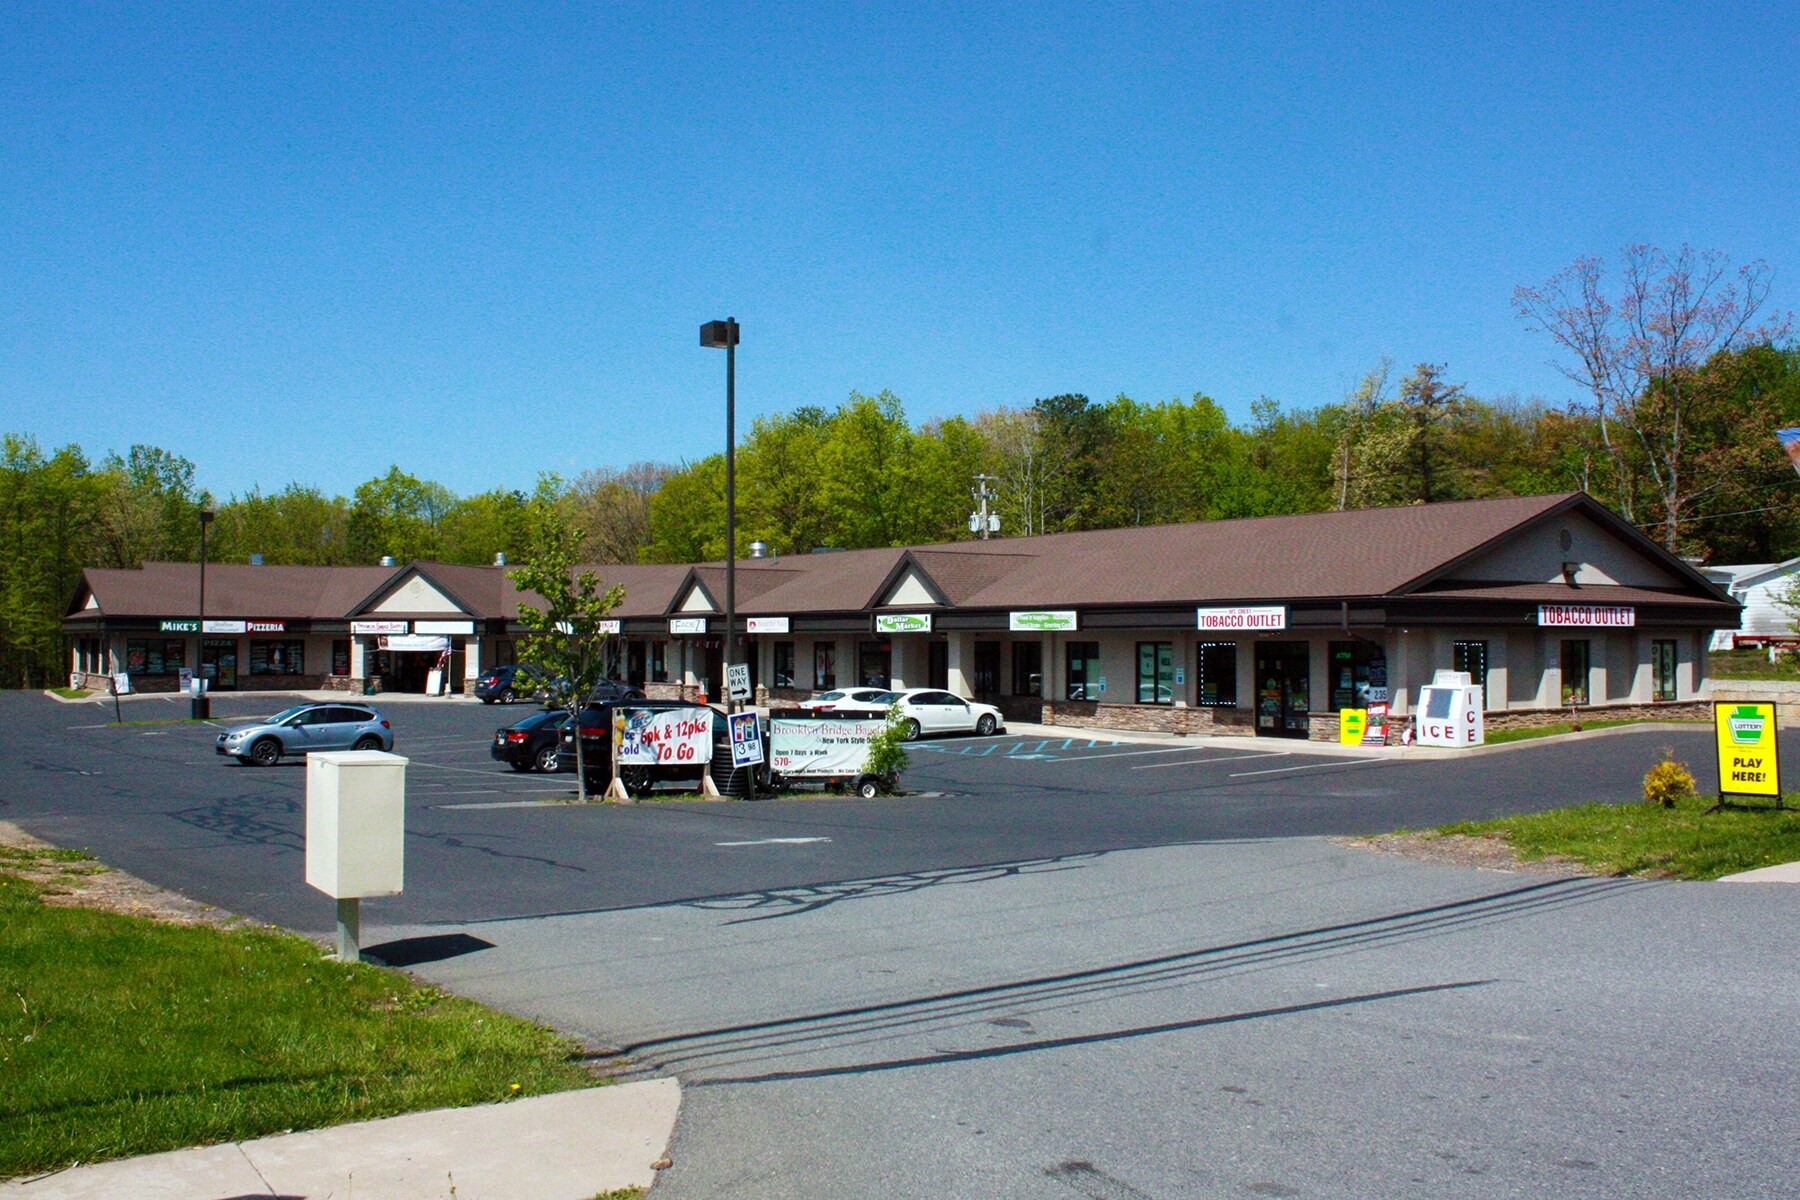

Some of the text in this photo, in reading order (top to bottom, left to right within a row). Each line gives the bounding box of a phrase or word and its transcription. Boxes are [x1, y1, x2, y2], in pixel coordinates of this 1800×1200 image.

[887, 616, 909, 624] Dollar
[1201, 614, 1282, 627] TOBACCO OUTLET
[1542, 606, 1632, 624] TOBACCO OUTLET
[162, 622, 197, 631] MIKE'S
[247, 623, 285, 631] PIZZERIA
[896, 622, 921, 631] Market
[729, 667, 745, 677] ONE
[730, 677, 747, 687] WAY
[1374, 690, 1387, 700] 235
[1466, 692, 1476, 742] ICE
[641, 718, 707, 747] 6pk & 12pks
[773, 723, 818, 737] Brooklyn
[821, 724, 851, 737] Bridge
[1422, 725, 1455, 740] ICE
[851, 737, 865, 745] Style
[617, 743, 639, 755] Cold
[657, 742, 695, 760] To Go
[776, 749, 789, 757] Open
[1733, 757, 1763, 769] PLAY
[1732, 771, 1766, 783] HERE!
